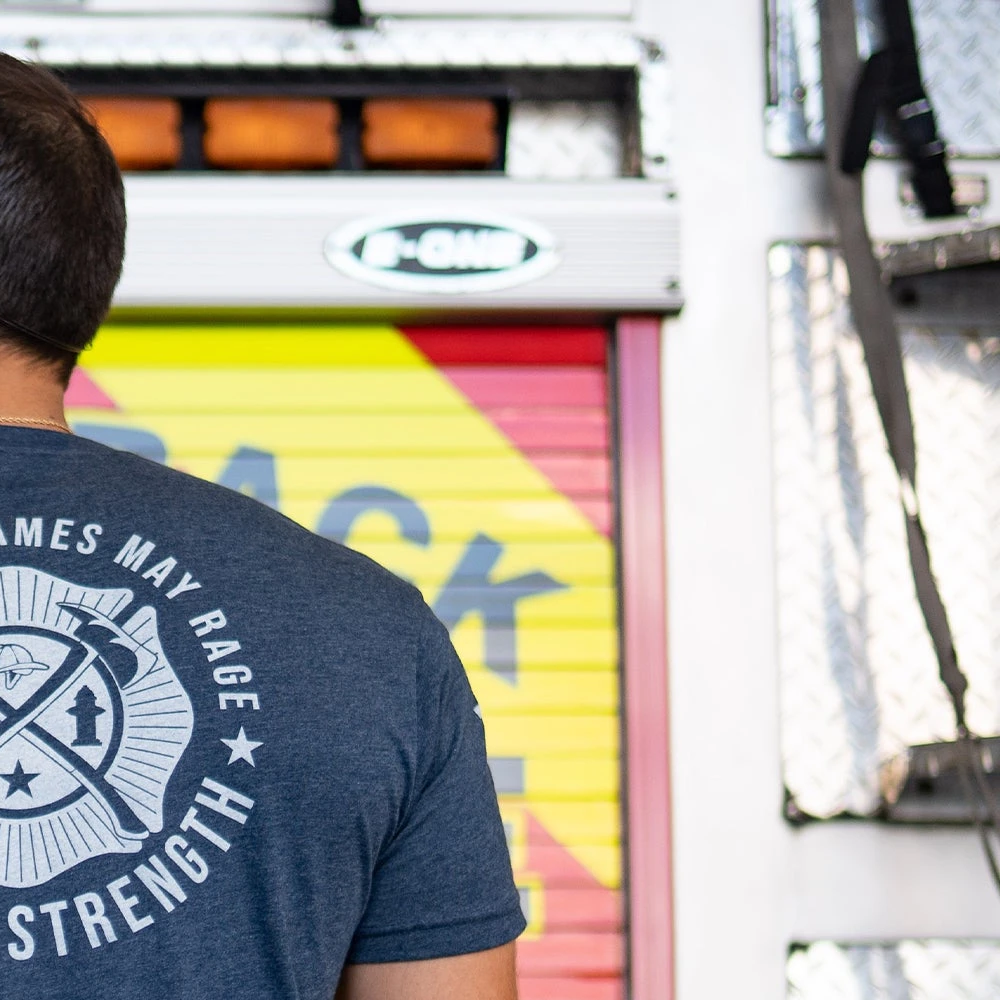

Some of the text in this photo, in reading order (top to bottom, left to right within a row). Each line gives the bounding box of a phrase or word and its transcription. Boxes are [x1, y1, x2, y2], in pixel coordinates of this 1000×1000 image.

[112, 533, 203, 600] MAY
[188, 608, 261, 711] RAGE
[7, 776, 255, 961] STRENGTH
